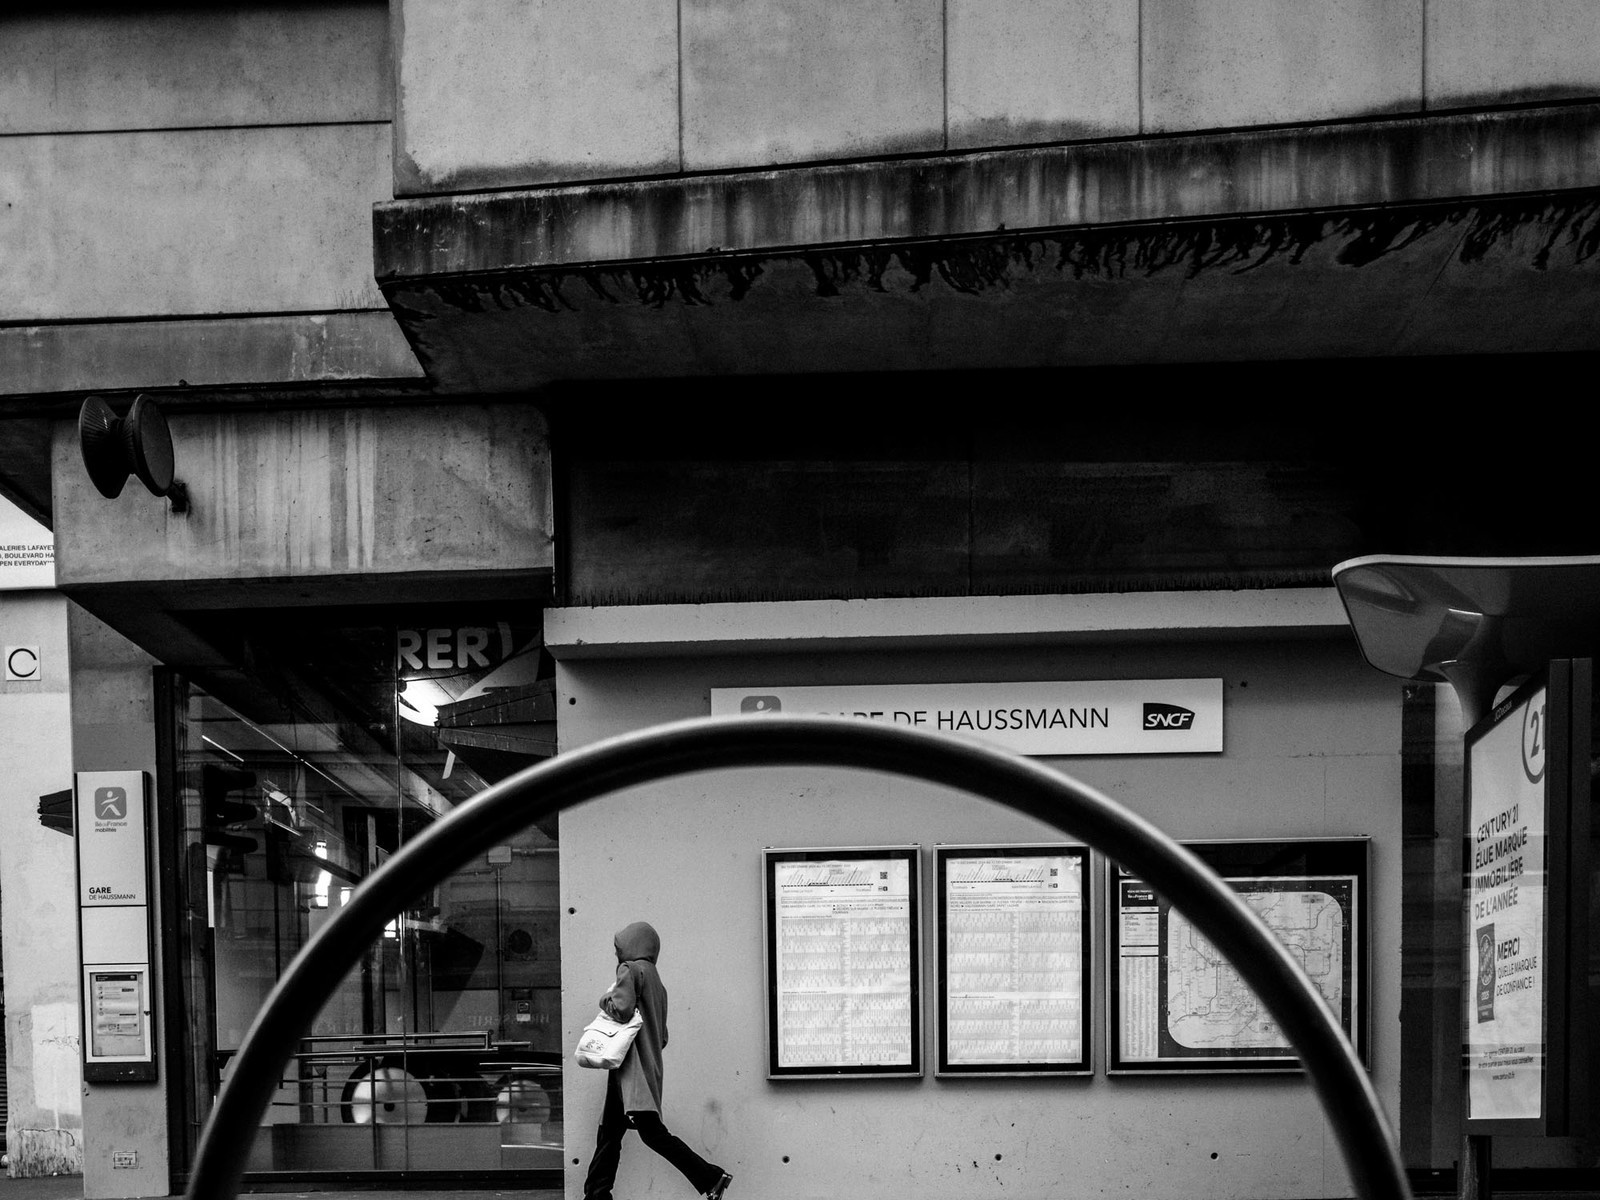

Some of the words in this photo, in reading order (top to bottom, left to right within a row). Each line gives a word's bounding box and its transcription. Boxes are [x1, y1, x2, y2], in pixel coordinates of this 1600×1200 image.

[938, 708, 1109, 731] HAUSSMANN
[1145, 713, 1193, 728] SNCF
[1477, 808, 1512, 844] CENTURY
[1512, 803, 1519, 824] 21
[1475, 847, 1493, 870] ÉLUE
[1495, 826, 1528, 861] MARQUE
[1475, 856, 1523, 895] IMMOBILIÈRE
[1475, 901, 1485, 920] DE
[1486, 882, 1519, 916] L'ANNÉE
[1497, 936, 1520, 961] MERCI
[1498, 963, 1514, 979] QUELLE
[1515, 956, 1537, 974] MARQUE
[1496, 984, 1503, 996] DE
[1503, 976, 1532, 994] CONFIANCE
